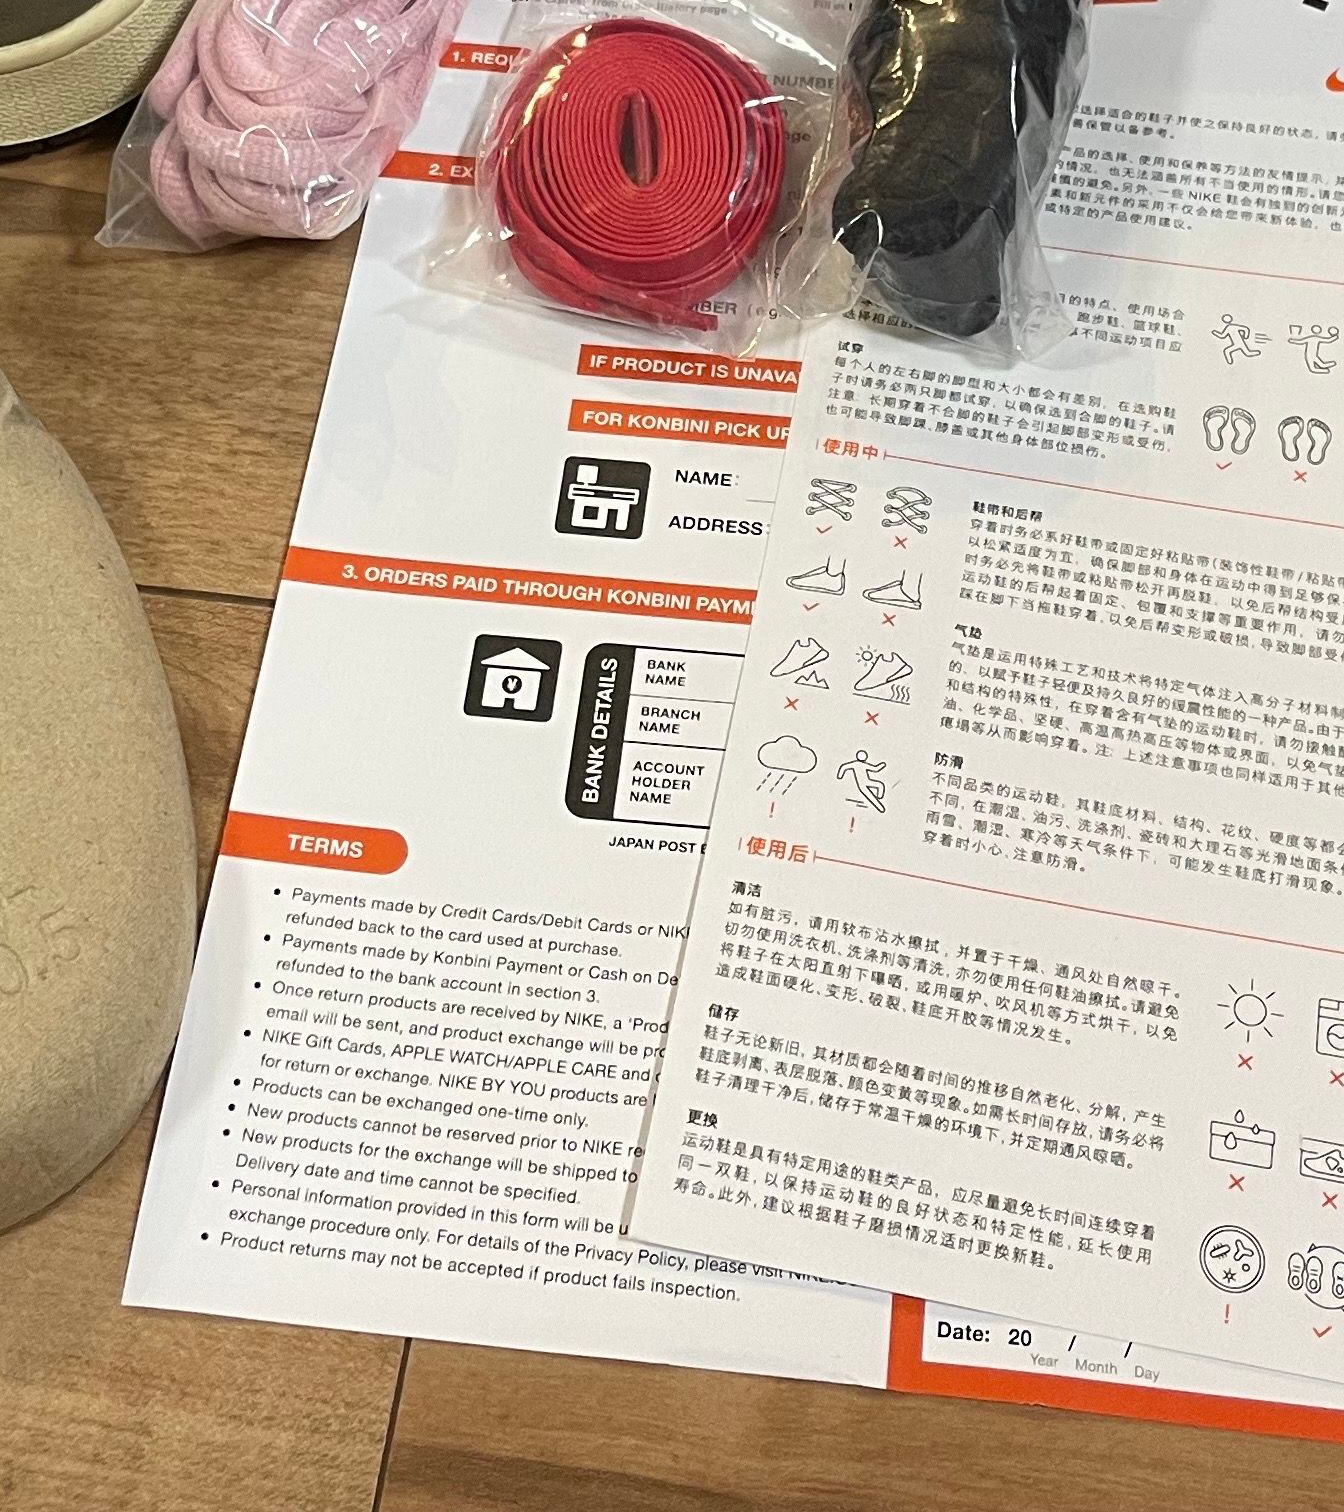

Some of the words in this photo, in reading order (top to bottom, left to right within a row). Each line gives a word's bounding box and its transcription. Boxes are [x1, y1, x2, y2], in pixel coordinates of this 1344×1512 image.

[453, 51, 465, 63] 1.
[428, 163, 443, 176] 2.
[590, 355, 607, 367] IF
[612, 357, 706, 375] PRODUCT
[711, 365, 728, 378] IS
[583, 411, 622, 426] FOR
[628, 415, 709, 433] KONBINI
[715, 422, 760, 437] PICK
[822, 438, 879, 462] 使用中
[676, 470, 739, 487] NAME:
[342, 565, 358, 579] 3.
[365, 567, 447, 588] ORDERS
[453, 575, 497, 592] PAID
[503, 580, 601, 601] THROUGH
[608, 589, 690, 609] KONBINI
[648, 660, 685, 672] BANK
[646, 674, 685, 686] NAME
[591, 658, 618, 740] DETAILS
[641, 707, 700, 721] BRANCH
[639, 721, 679, 734] NAME
[582, 745, 607, 803] BANK
[633, 761, 704, 775] ACCOUNT
[632, 776, 690, 790] HOLDER
[630, 791, 671, 804] NAME
[289, 834, 363, 858] TERMS
[609, 837, 654, 849] JAPAN
[659, 841, 696, 853] POST
[746, 835, 809, 866] 使用后
[731, 880, 761, 898] 清洁
[708, 1003, 740, 1022] 储存
[252, 1077, 322, 1100] Products
[327, 1090, 356, 1103] can
[361, 1088, 381, 1105] be
[386, 1096, 473, 1117] exchanged
[478, 1104, 548, 1123] one-time
[553, 1112, 589, 1131] only.
[687, 1109, 718, 1129] 更换
[242, 1128, 278, 1145] New
[281, 1136, 353, 1155] products
[358, 1141, 380, 1157] for
[385, 1144, 409, 1161] the
[415, 1150, 492, 1171] exchange
[497, 1157, 522, 1172] will
[528, 1159, 547, 1175] be
[552, 1162, 617, 1183] shipped
[623, 1168, 638, 1184] to
[236, 1153, 300, 1178] Delivery
[304, 1162, 339, 1179] date
[344, 1169, 375, 1183] and
[380, 1170, 414, 1187] time
[419, 1177, 473, 1194] cannot
[479, 1180, 499, 1196] be
[504, 1184, 582, 1206] specified.
[220, 1231, 285, 1254] Product
[289, 1240, 346, 1261] returns
[351, 1250, 387, 1269] may
[390, 1251, 417, 1268] not
[422, 1254, 442, 1271] be
[447, 1258, 524, 1280] accepted
[528, 1265, 541, 1281] if
[543, 1270, 607, 1289] product
[613, 1273, 645, 1292] fails
[650, 1278, 741, 1304] inspection.
[938, 1321, 989, 1342] Date:
[1008, 1329, 1031, 1346] 20
[1031, 1353, 1058, 1367] Year
[1076, 1358, 1117, 1374] Month
[1135, 1366, 1160, 1382] Day
